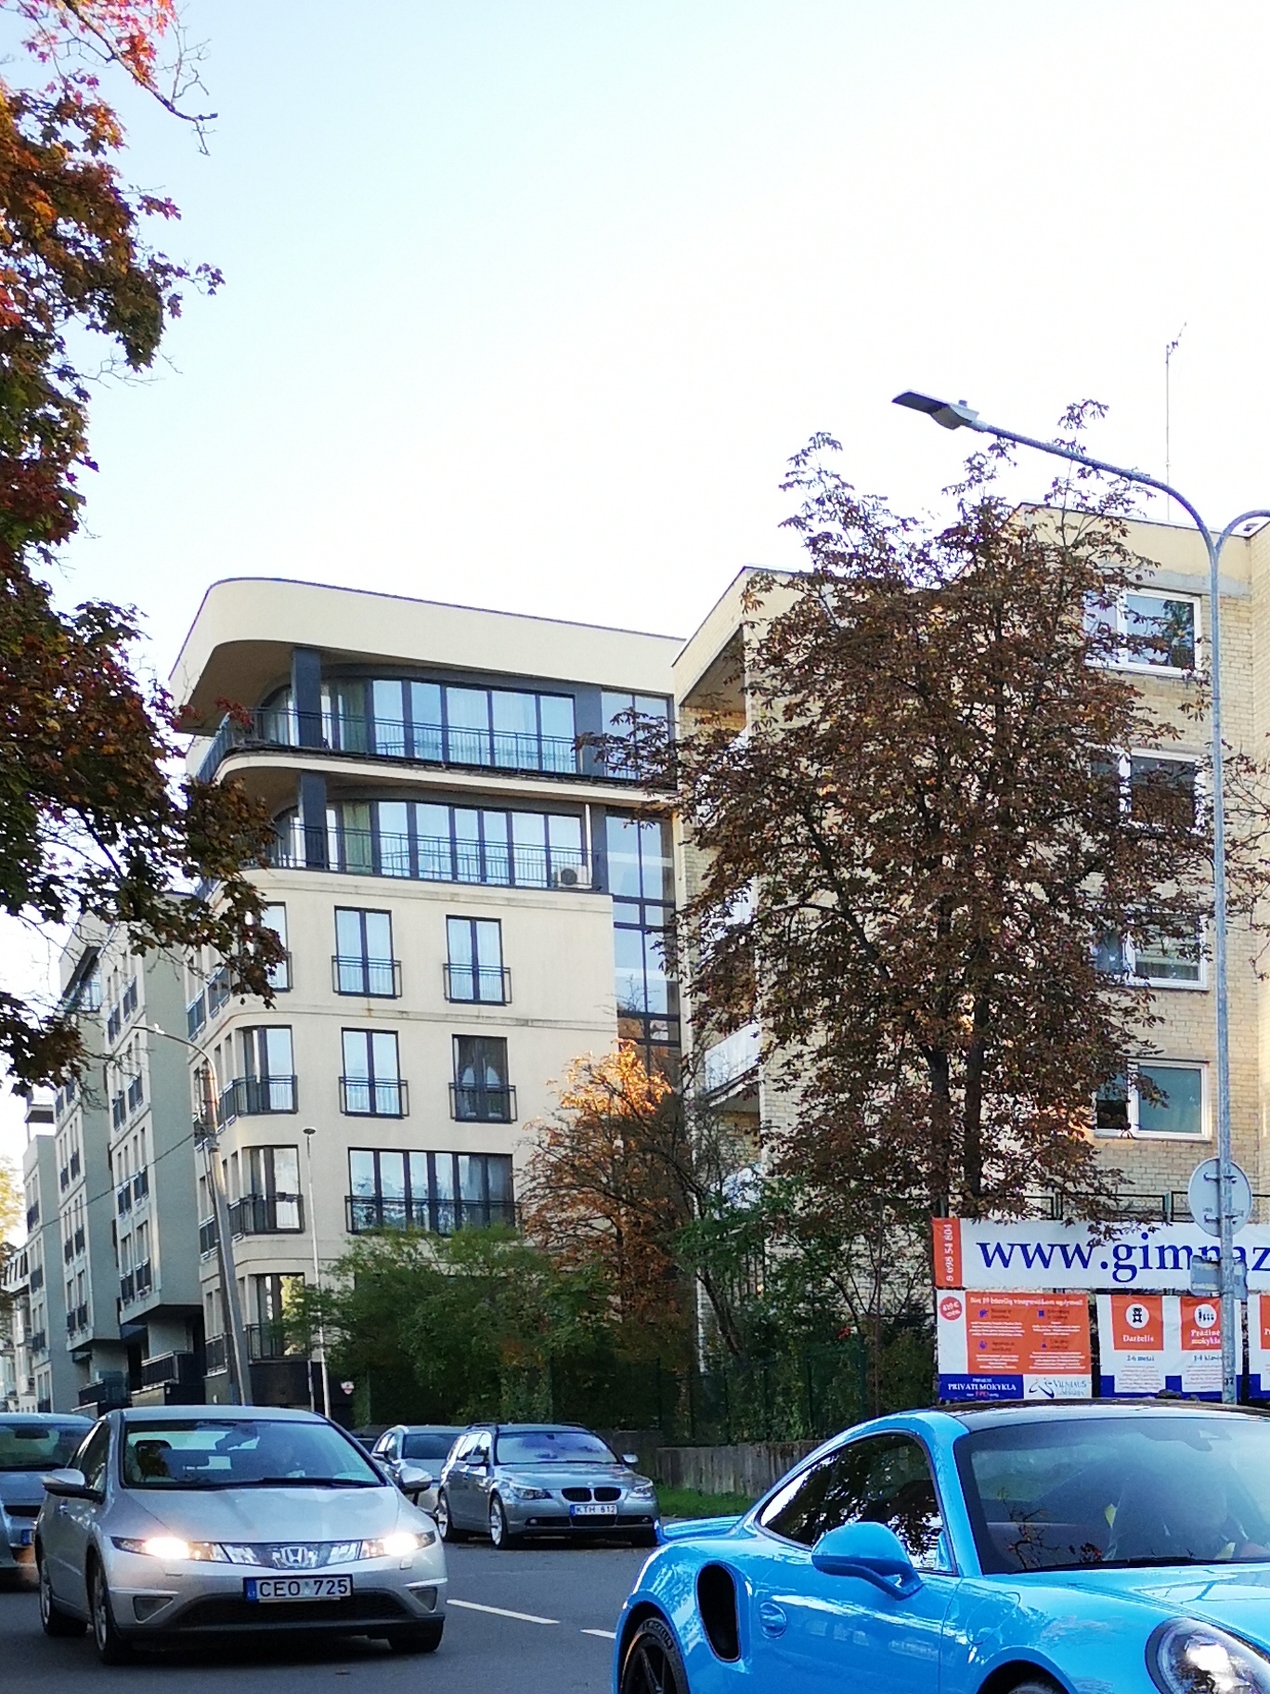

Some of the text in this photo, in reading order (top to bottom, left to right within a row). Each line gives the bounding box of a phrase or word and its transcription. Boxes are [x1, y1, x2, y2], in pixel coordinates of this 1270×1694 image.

[979, 1383, 1017, 1391] MOKYKLA
[260, 1579, 348, 1597] CEO 725
